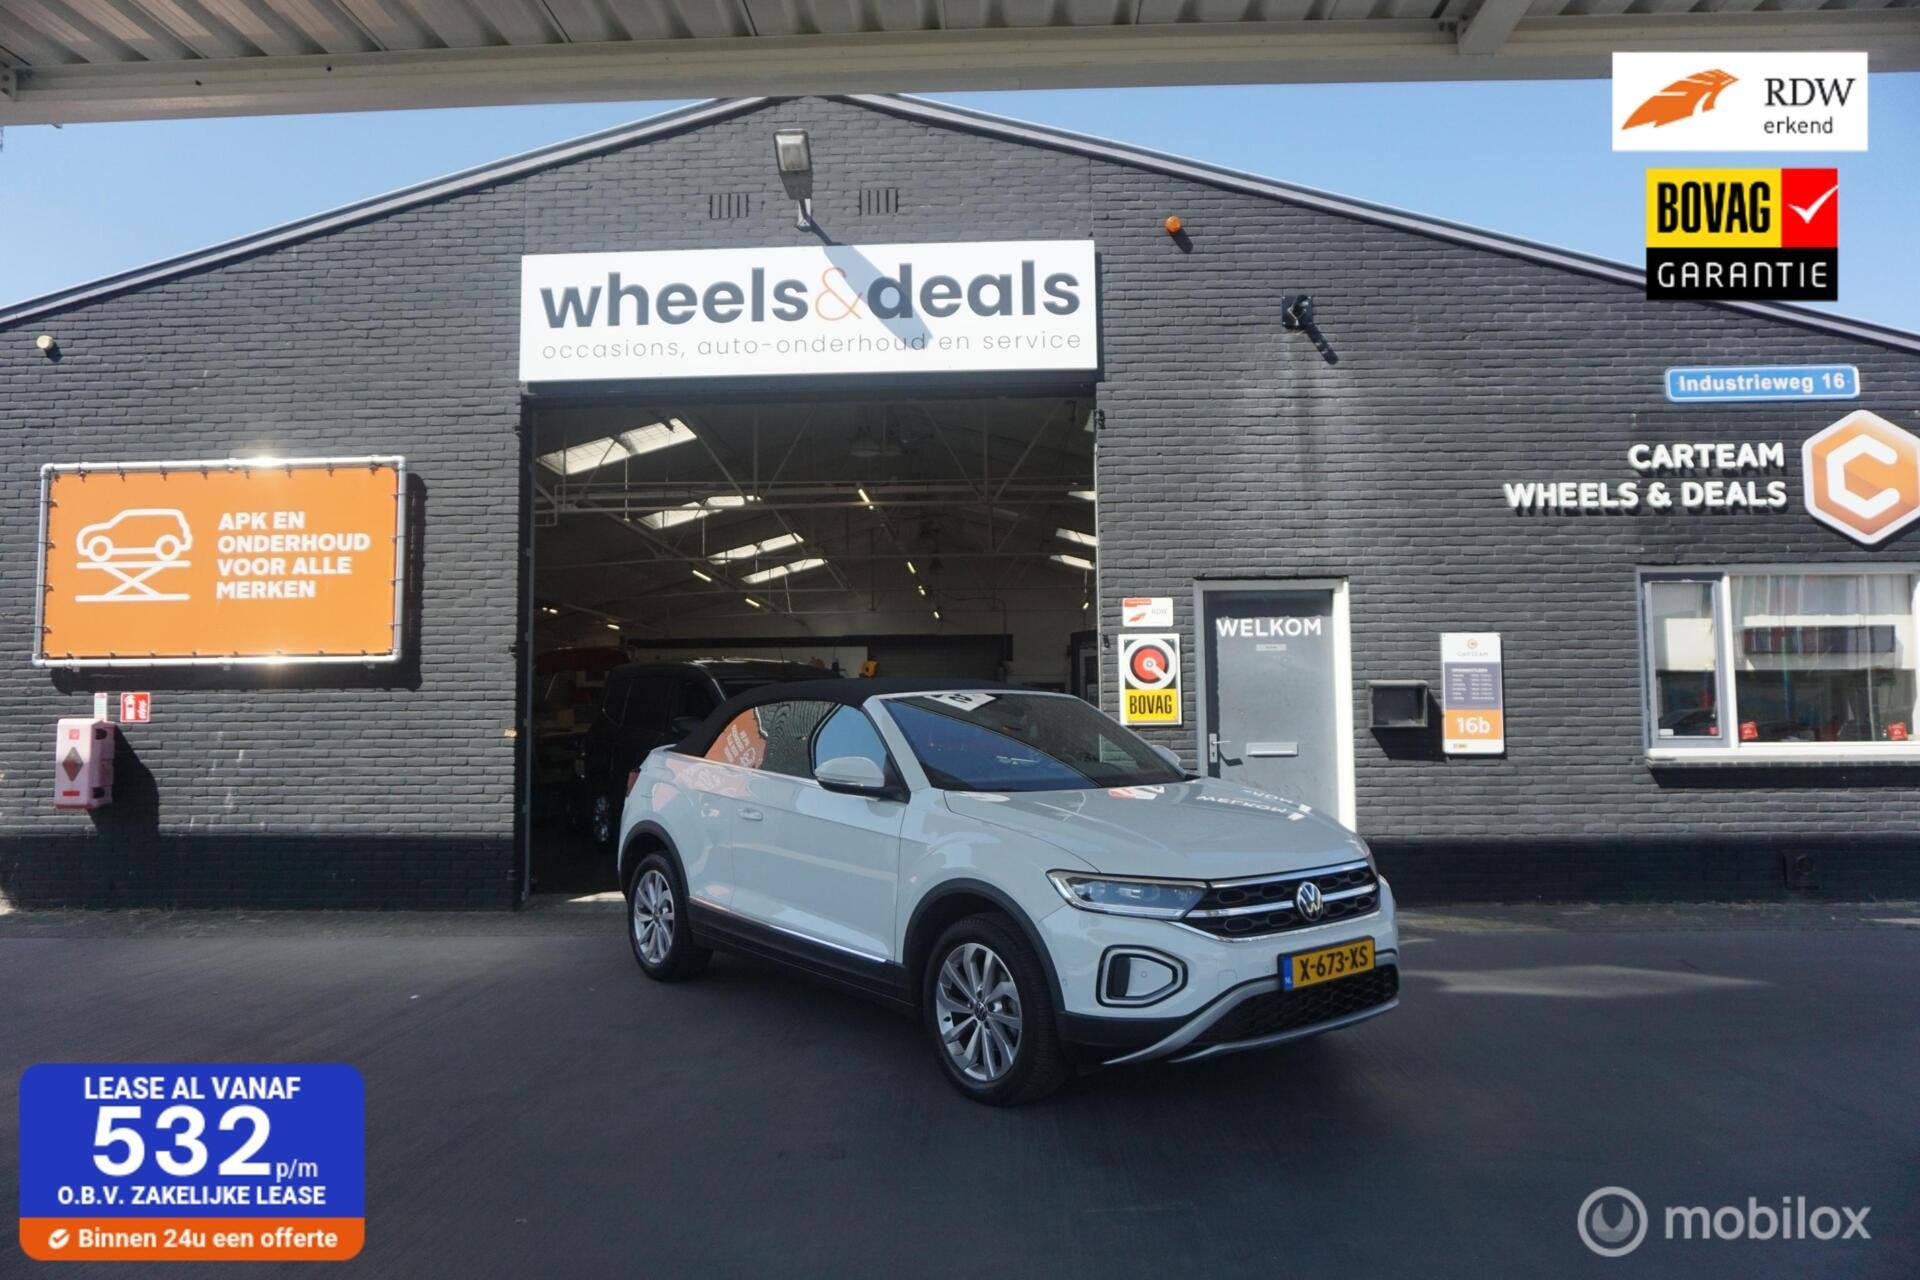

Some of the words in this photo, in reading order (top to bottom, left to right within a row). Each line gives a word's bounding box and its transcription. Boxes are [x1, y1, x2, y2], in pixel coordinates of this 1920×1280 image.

[542, 338, 687, 361] occasions,
[697, 331, 927, 354] auto-onderhoud
[939, 336, 970, 351] en
[982, 330, 1081, 350] service
[1678, 373, 1815, 394] Industrieweg
[1822, 372, 1846, 389] 16
[1628, 442, 1786, 470] CARTEAM
[1503, 482, 1640, 508] WHEELS
[1647, 482, 1673, 508] &
[1682, 480, 1787, 508] DEALS
[218, 512, 268, 531] APK
[272, 511, 305, 530] EN
[217, 532, 371, 553] ONDERHOUD
[217, 556, 288, 577] VOOR
[292, 556, 353, 575] ALLE
[216, 580, 317, 600] MERKEN
[1215, 617, 1322, 638] WELKOM
[1129, 695, 1173, 715] BOVAG
[1457, 717, 1491, 734] 16b
[1299, 944, 1369, 982] X-673-XS
